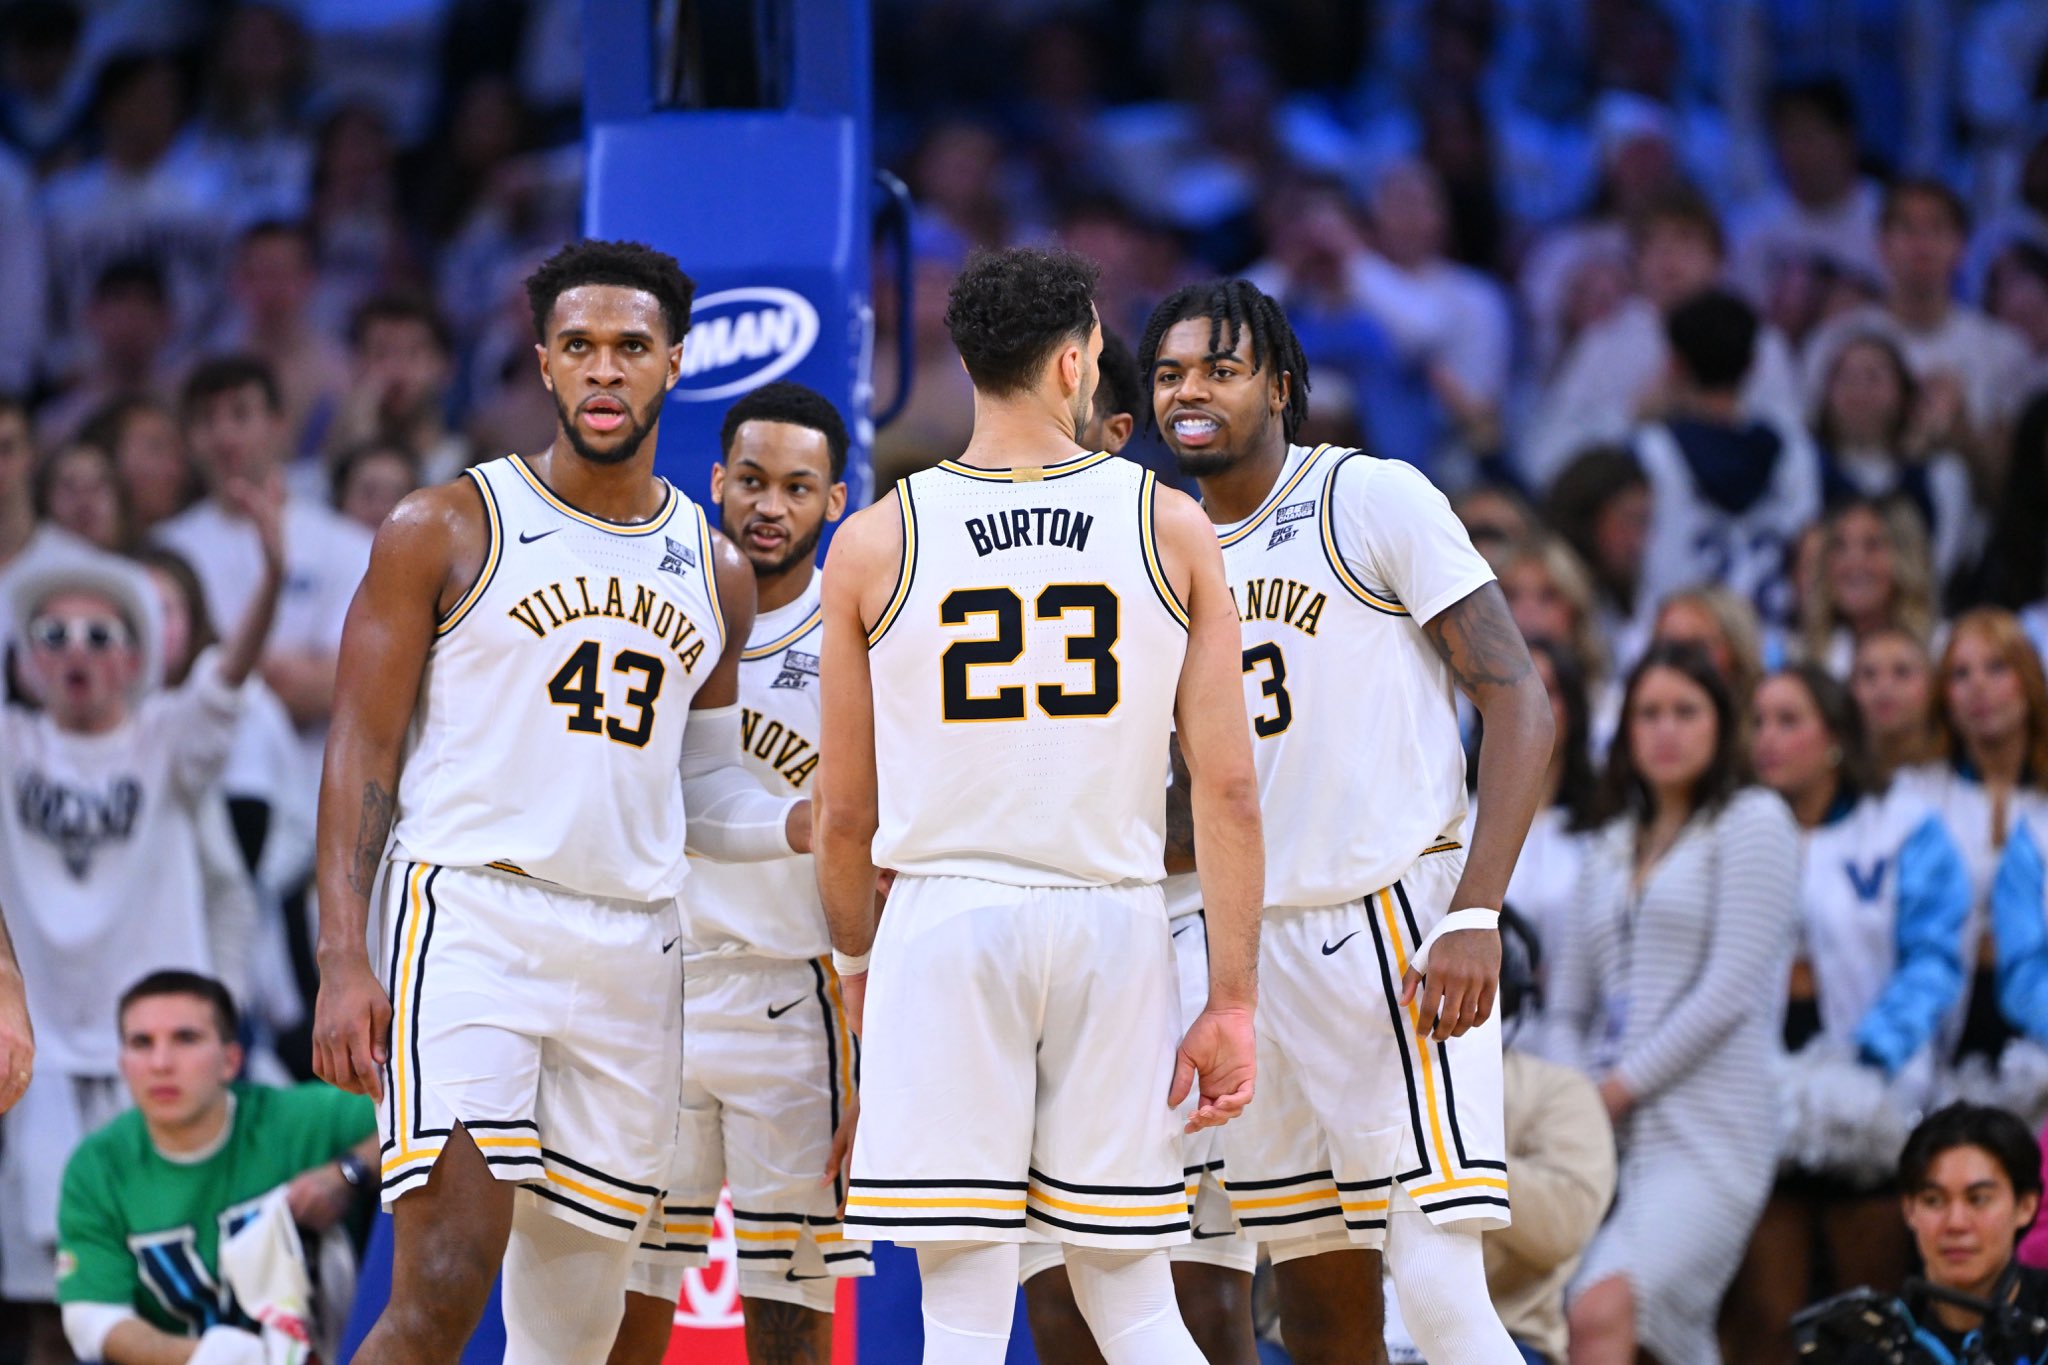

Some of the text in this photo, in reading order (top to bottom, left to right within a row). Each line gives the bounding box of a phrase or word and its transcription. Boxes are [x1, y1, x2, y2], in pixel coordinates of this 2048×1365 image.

[965, 507, 1094, 557] BURTON
[1268, 529, 1299, 547] EAST
[1271, 525, 1293, 538] BIG
[659, 561, 687, 576] EAST
[663, 554, 683, 567] BIG
[507, 575, 706, 675] VILLANOVA
[938, 581, 1121, 723] 23
[546, 640, 665, 749] 43
[1844, 858, 1889, 901] V
